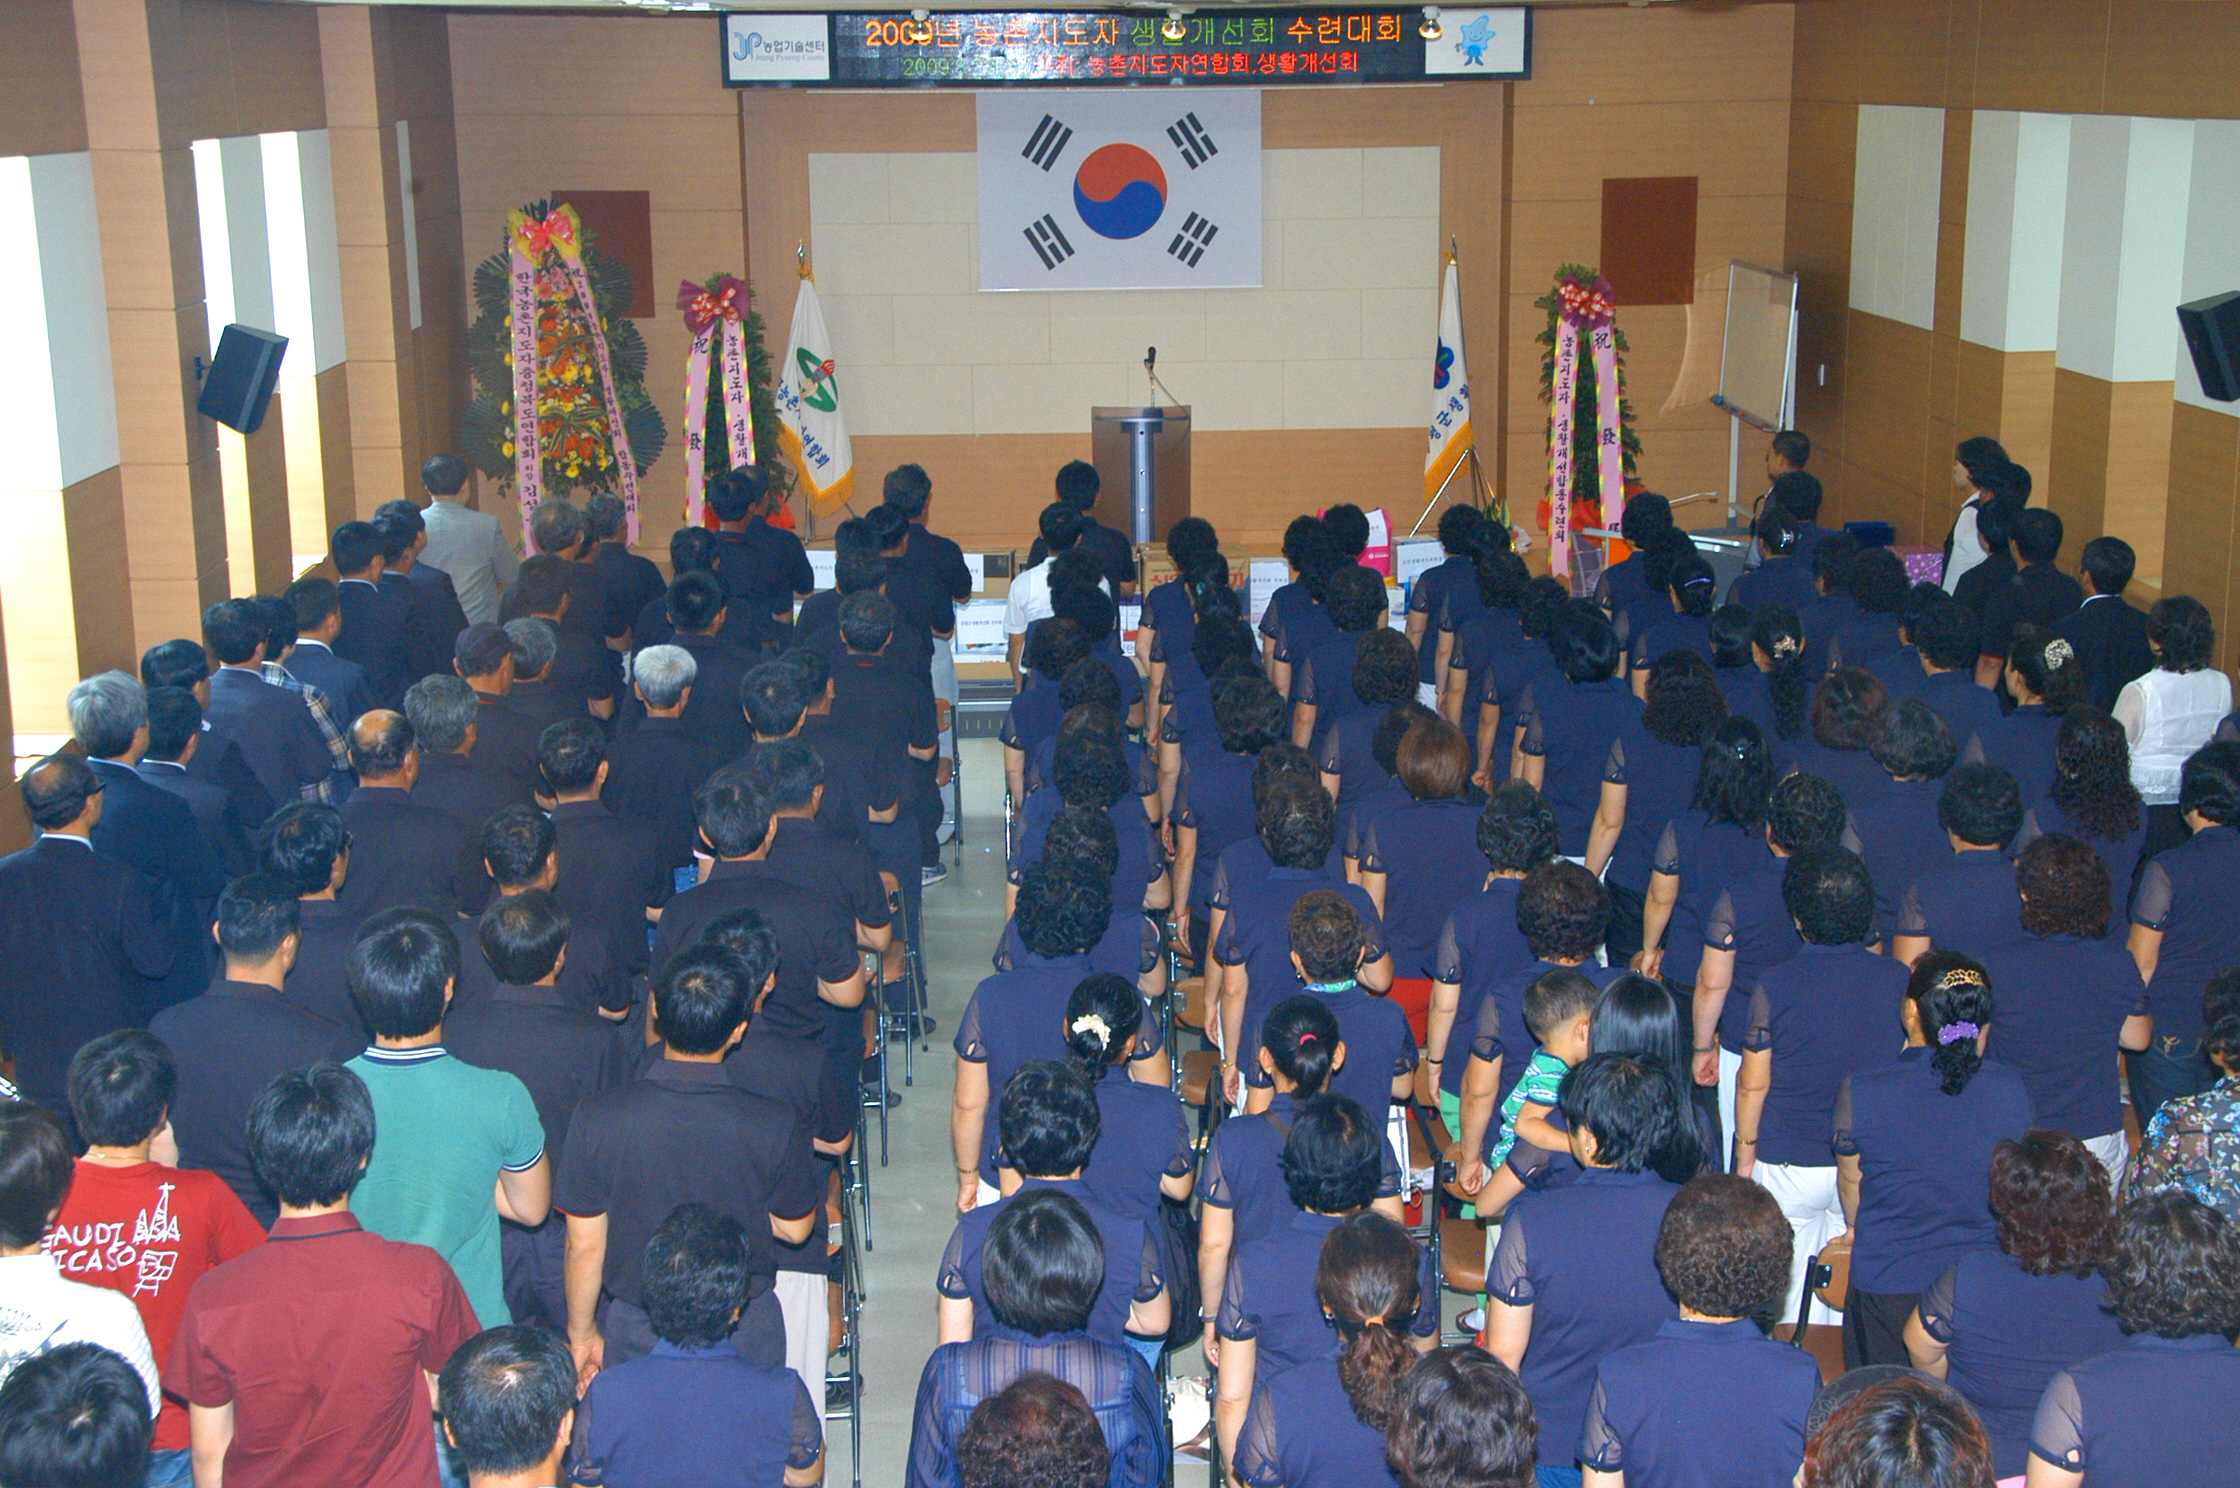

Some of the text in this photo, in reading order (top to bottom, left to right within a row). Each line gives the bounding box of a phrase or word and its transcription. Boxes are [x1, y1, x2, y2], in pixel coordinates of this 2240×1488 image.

[974, 18, 1119, 46] 농촌지도자
[1287, 15, 1401, 44] 수련대회
[763, 40, 825, 53] 농업기술센터
[1594, 333, 1611, 350] 祝
